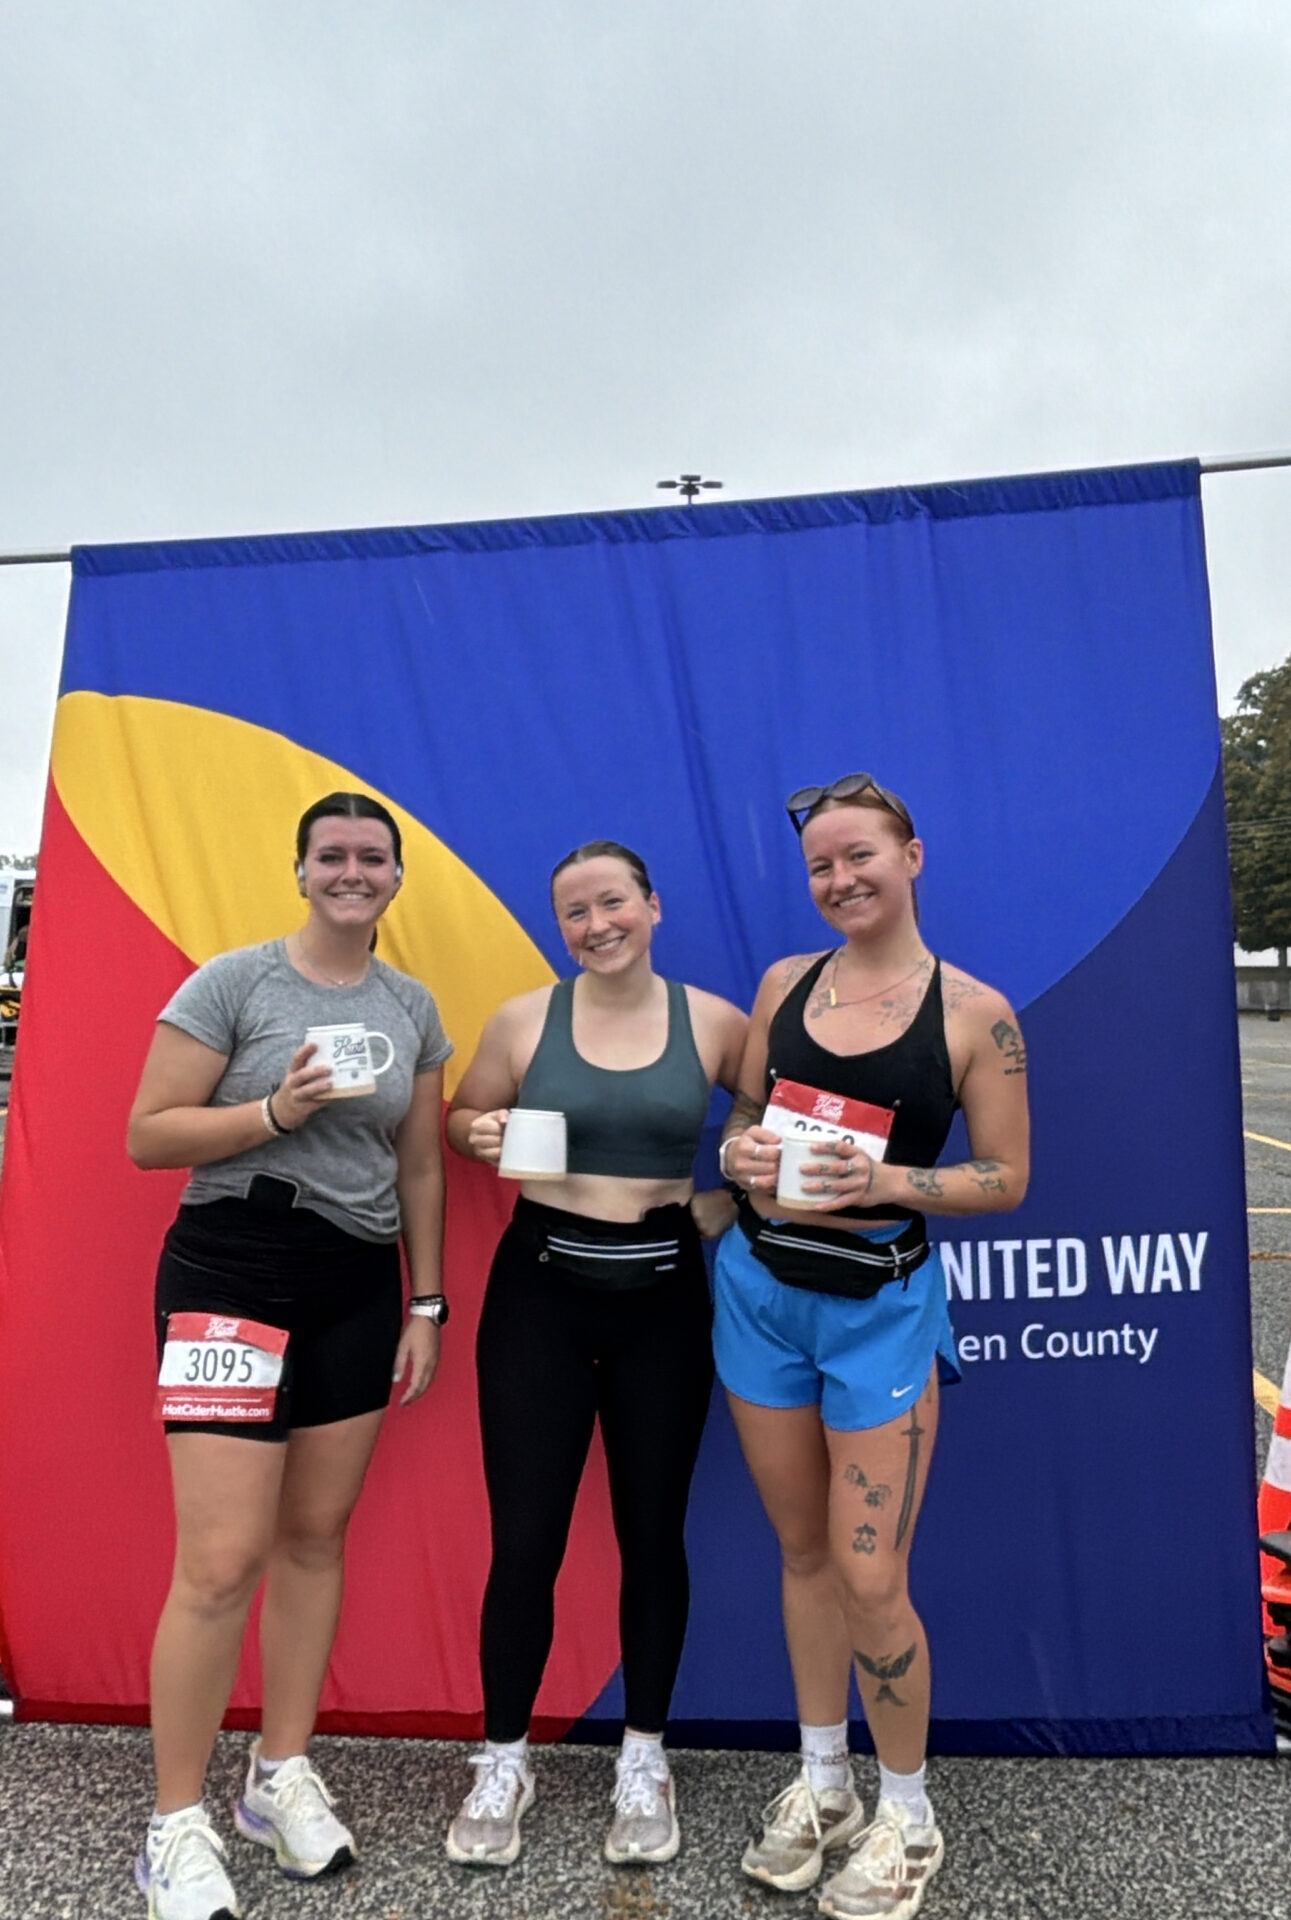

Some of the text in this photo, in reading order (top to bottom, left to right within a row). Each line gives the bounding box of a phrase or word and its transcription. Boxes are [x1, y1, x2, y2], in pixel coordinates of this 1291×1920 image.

[929, 1231, 1208, 1301] NITED WAY
[950, 1323, 1159, 1364] en County
[185, 1347, 253, 1383] 3095
[161, 1403, 270, 1417] HotCiderHustle.com
